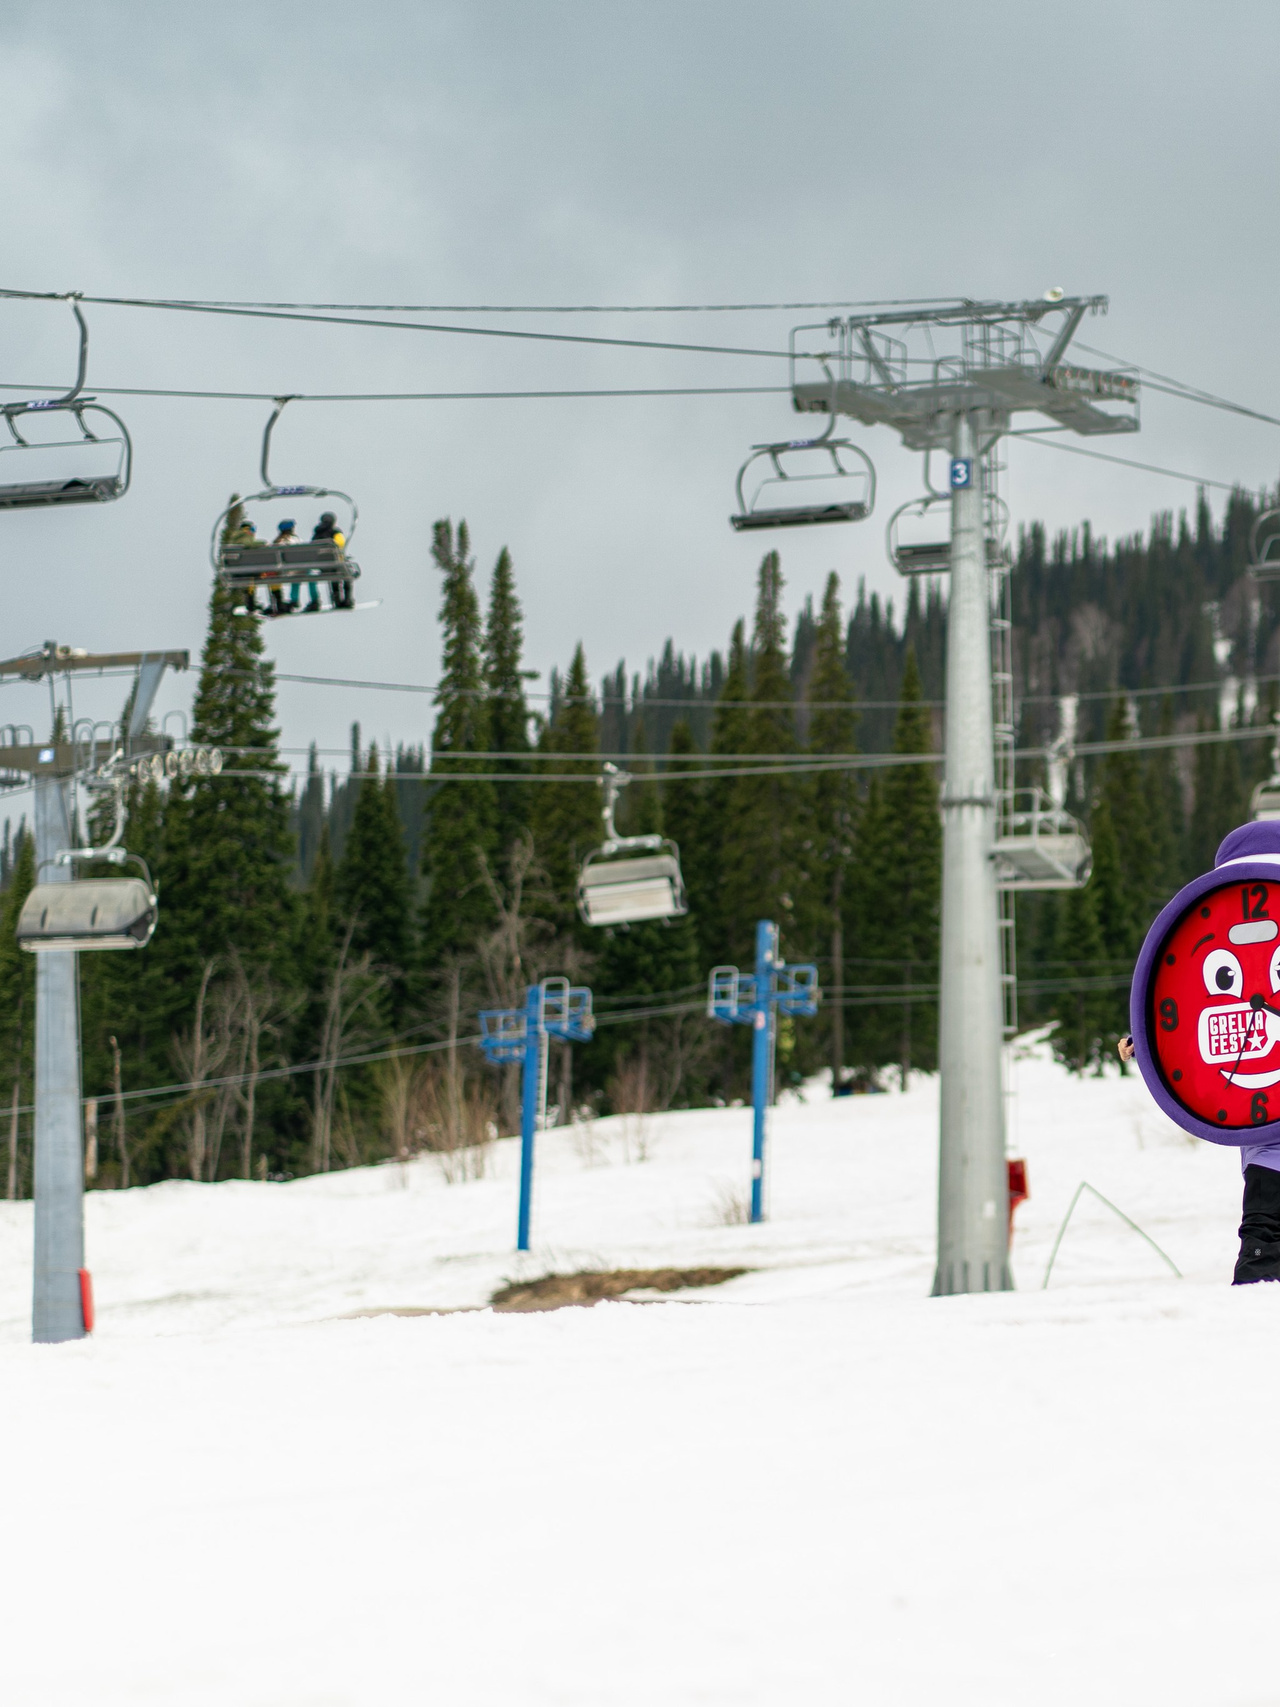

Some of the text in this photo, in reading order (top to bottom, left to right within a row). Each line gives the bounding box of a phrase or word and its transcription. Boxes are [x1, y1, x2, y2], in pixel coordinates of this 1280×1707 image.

[953, 463, 967, 484] 3
[1241, 884, 1269, 920] 12
[1160, 998, 1178, 1031] 9
[1209, 1010, 1264, 1035] GRELKA
[1210, 1032, 1247, 1055] FEST
[1250, 1091, 1267, 1124] 6
